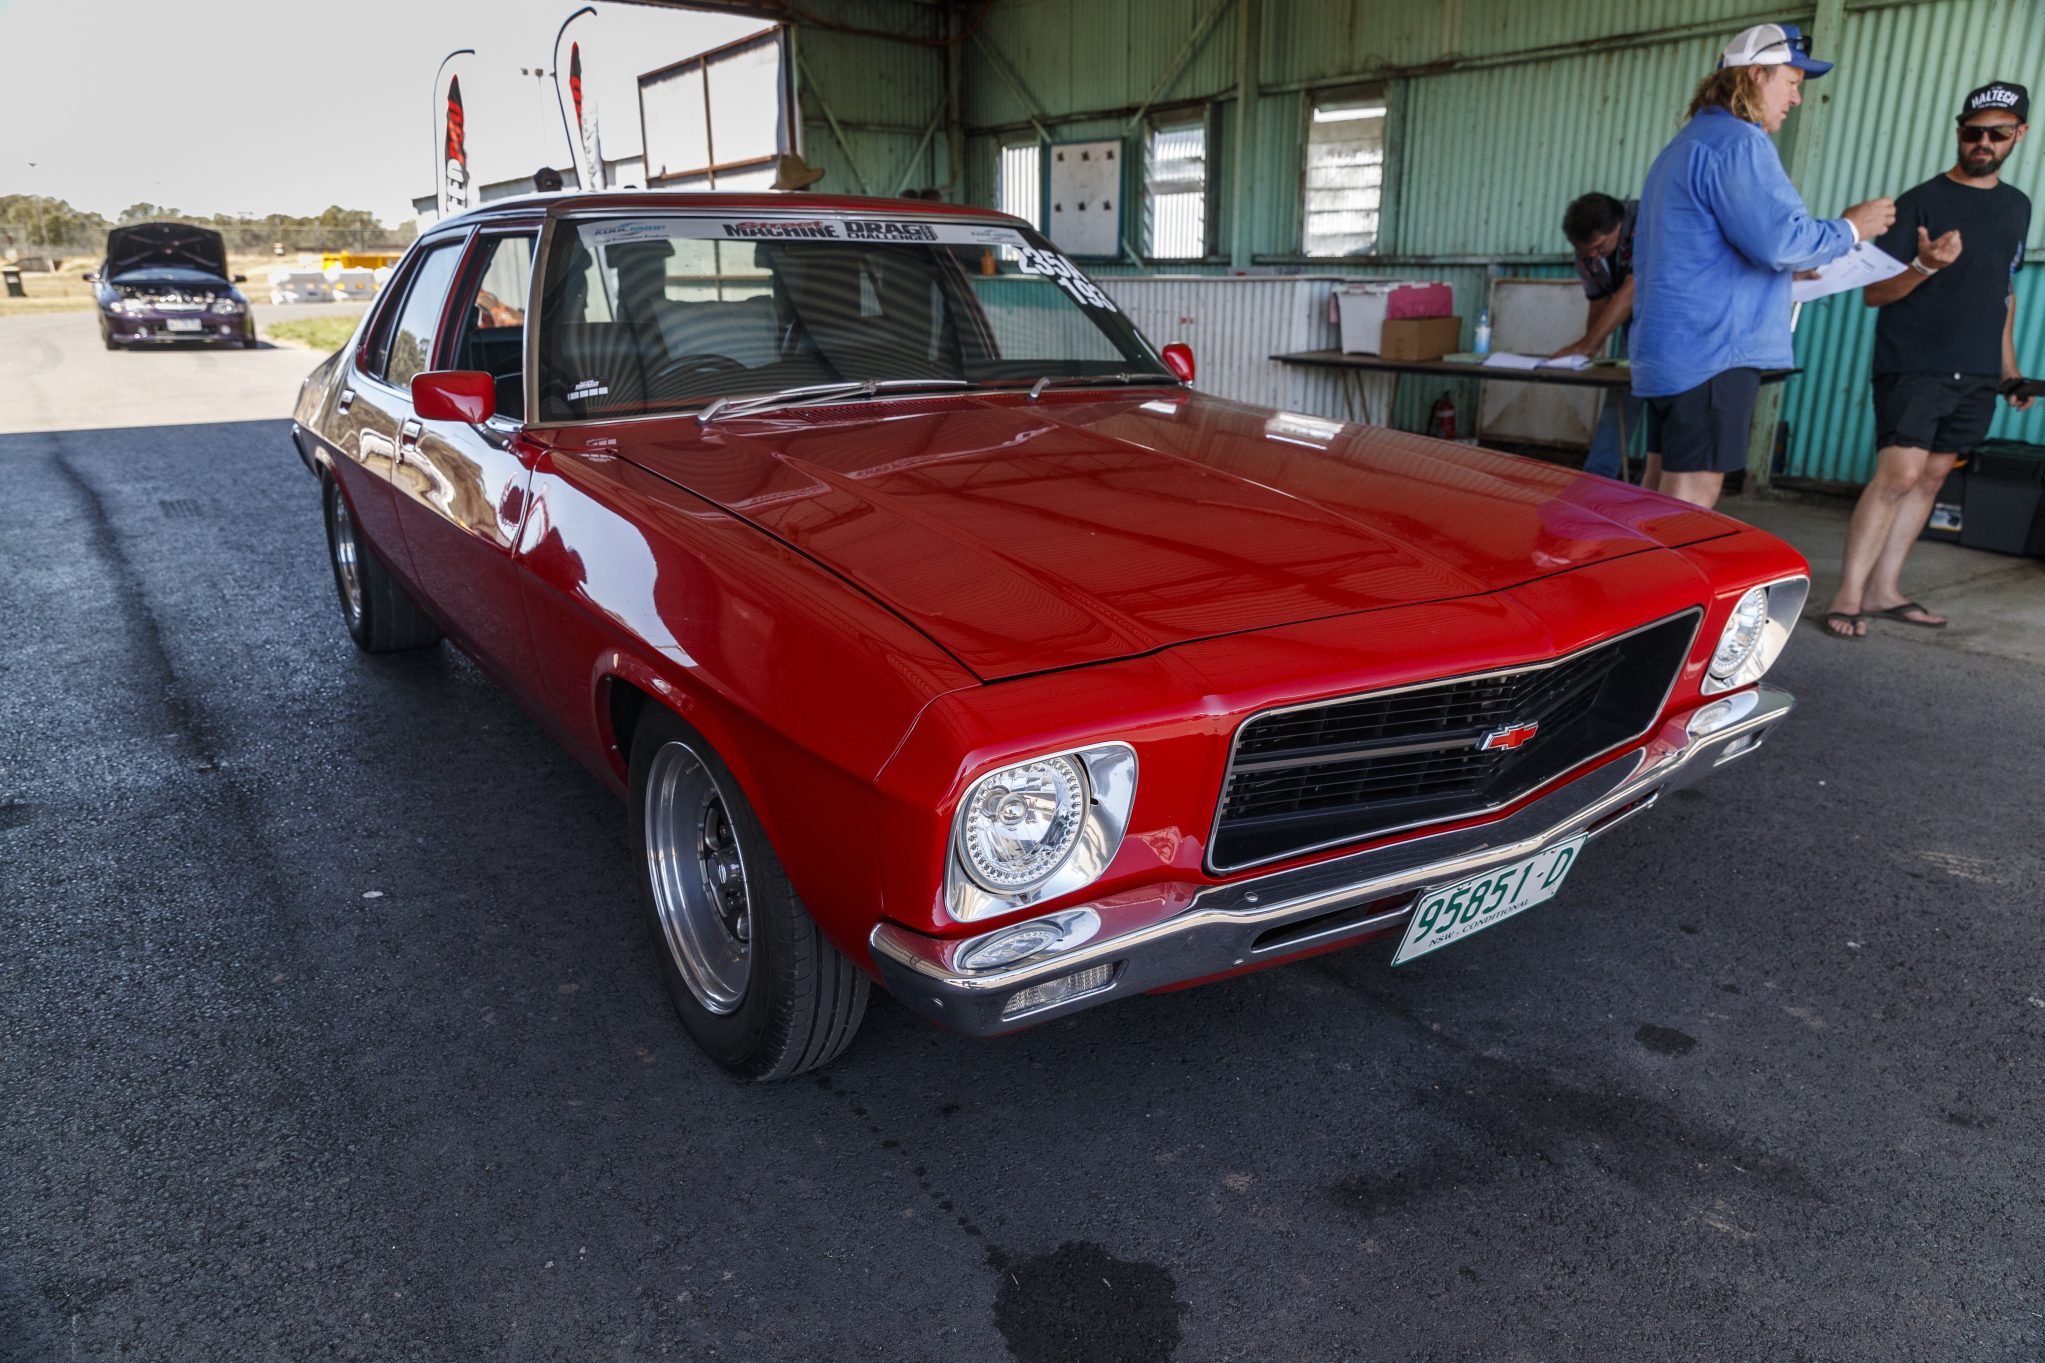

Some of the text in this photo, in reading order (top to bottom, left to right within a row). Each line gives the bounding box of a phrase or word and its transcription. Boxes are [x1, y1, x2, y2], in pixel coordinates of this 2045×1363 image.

[723, 224, 840, 238] MACHINE
[844, 221, 922, 235] DRAG
[1057, 276, 1118, 312] 193
[1429, 930, 1455, 947] NSW
[1462, 899, 1529, 933] CONDITIONAL
